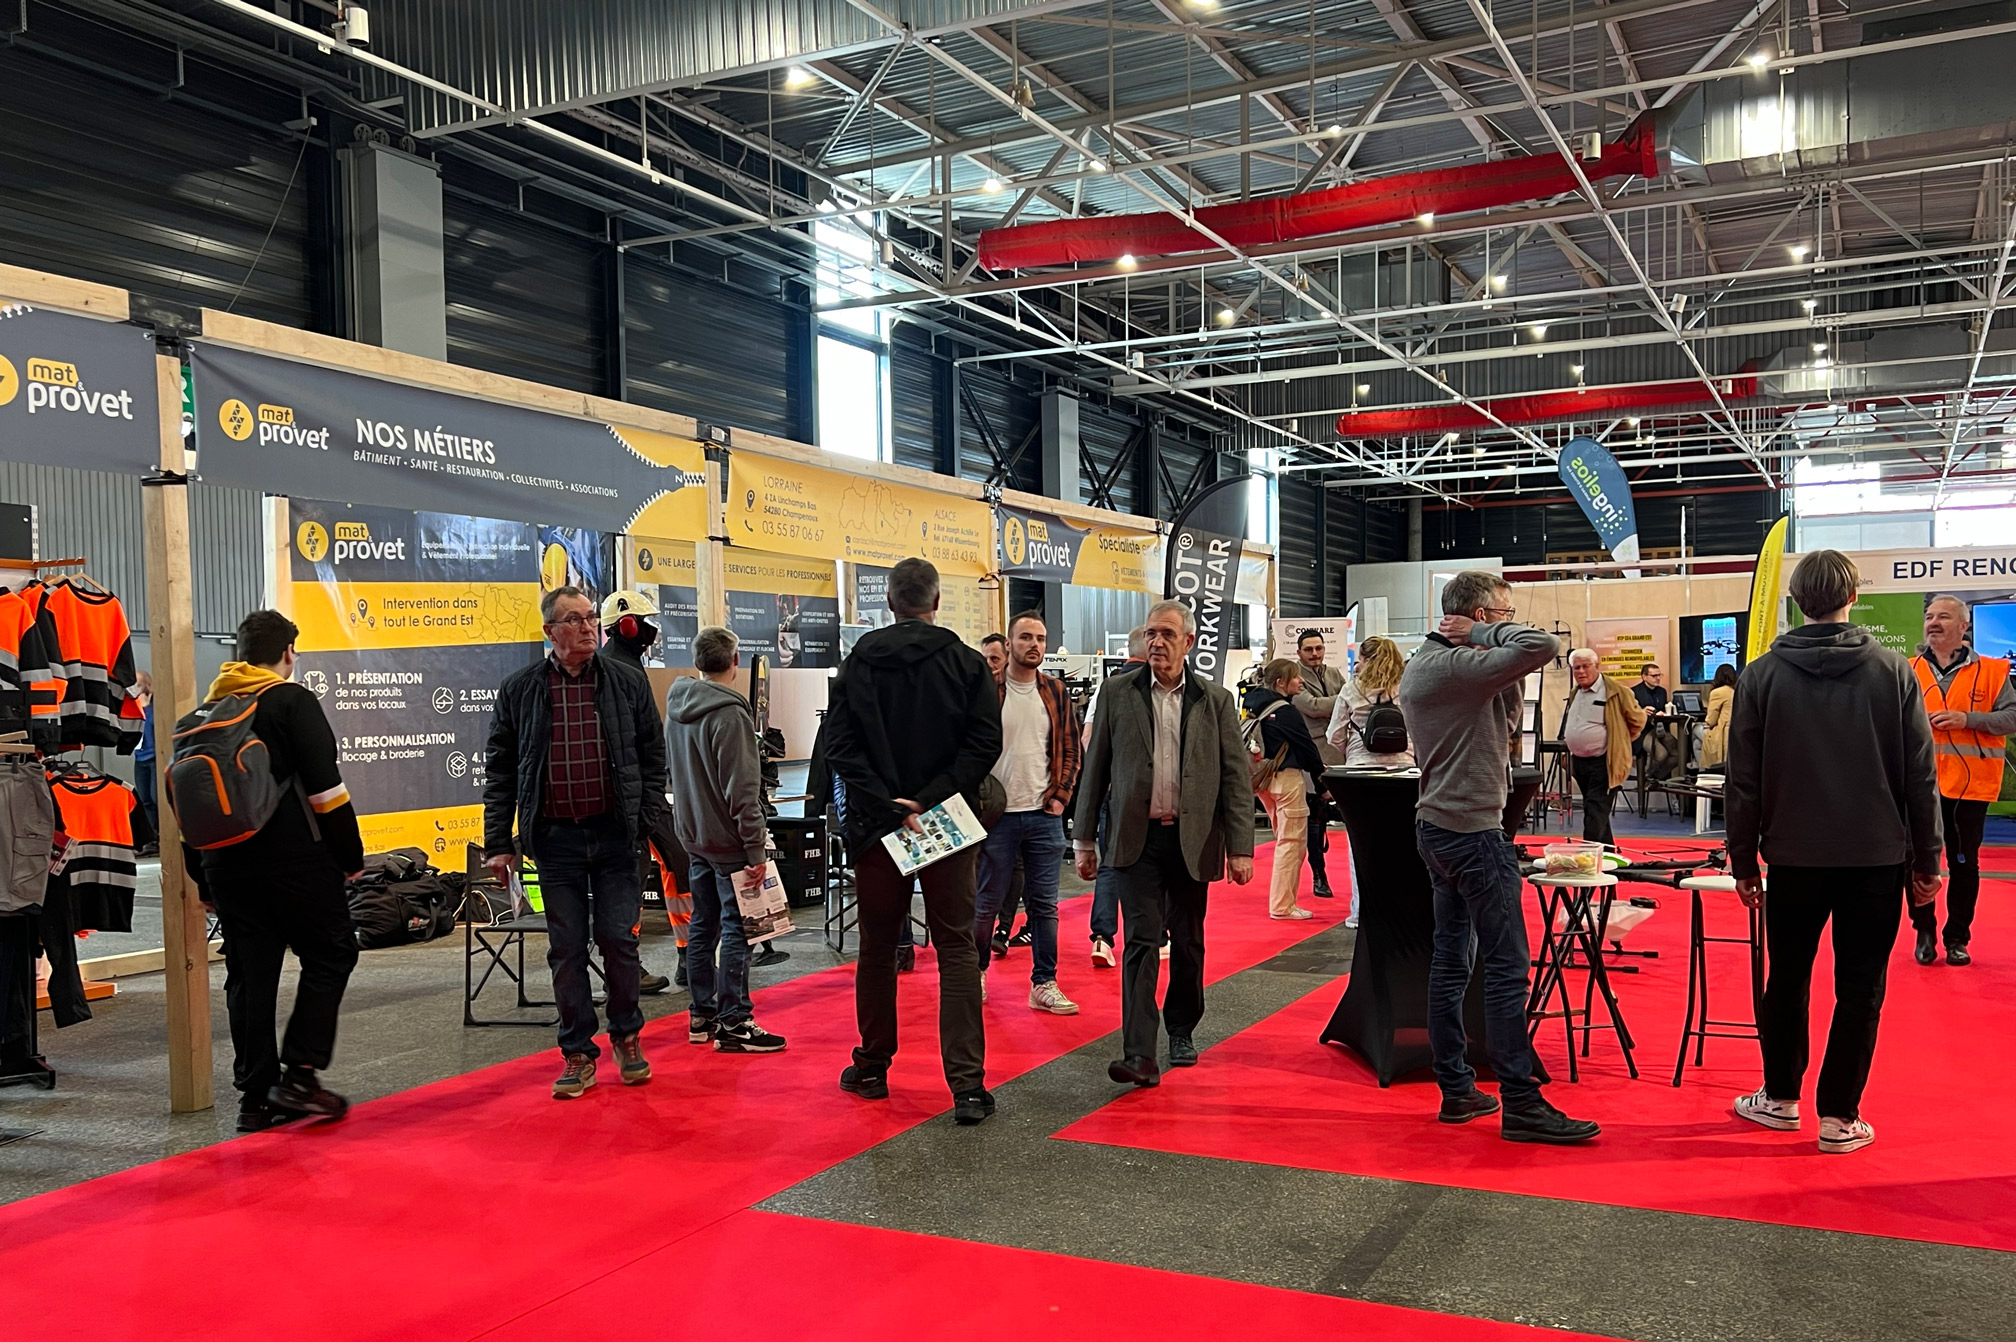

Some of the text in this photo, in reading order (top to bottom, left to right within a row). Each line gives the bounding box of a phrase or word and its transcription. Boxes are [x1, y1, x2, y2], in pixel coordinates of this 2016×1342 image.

[33, 364, 73, 383] mat
[27, 382, 133, 420] provet
[262, 407, 290, 423] mat
[259, 422, 330, 450] provet
[356, 418, 496, 465] NOS MÉTIERS
[353, 450, 618, 498] BÂTIMENT SANTÉ RESTAURATION COLLECTIVITÉS ASSOCIATIONS
[763, 475, 803, 494] LORRAINE
[782, 509, 818, 522] Champenoux
[934, 510, 956, 522] ALSACE
[338, 525, 366, 538] mat
[762, 520, 824, 542] 03 55 87 06 67
[1029, 524, 1047, 539] mat
[334, 538, 406, 564] provet
[1098, 533, 1141, 555] Spécialiste
[1028, 541, 1071, 569] provet
[658, 557, 672, 567] UNE
[673, 558, 696, 569] LARGE
[728, 566, 757, 575] SERVICES
[758, 567, 775, 577] POUR
[776, 569, 786, 578] LES
[786, 570, 832, 582] PROFESSIONNELS
[1893, 560, 1943, 579] EDF
[384, 598, 478, 610] Intervention dans
[384, 614, 474, 627] tout le Grand Est
[336, 669, 423, 685] 1. PRÉSENTATION
[336, 686, 402, 698] de nos produits
[460, 690, 468, 700] 2.
[336, 700, 406, 710] dans vos locaux
[460, 703, 494, 712] dans vos
[342, 732, 455, 749] 3. PERSONNALISATION
[342, 748, 424, 763] flocage & broderie
[472, 752, 481, 762] 4.
[473, 778, 480, 786] &
[448, 818, 480, 830] 03 55 87
